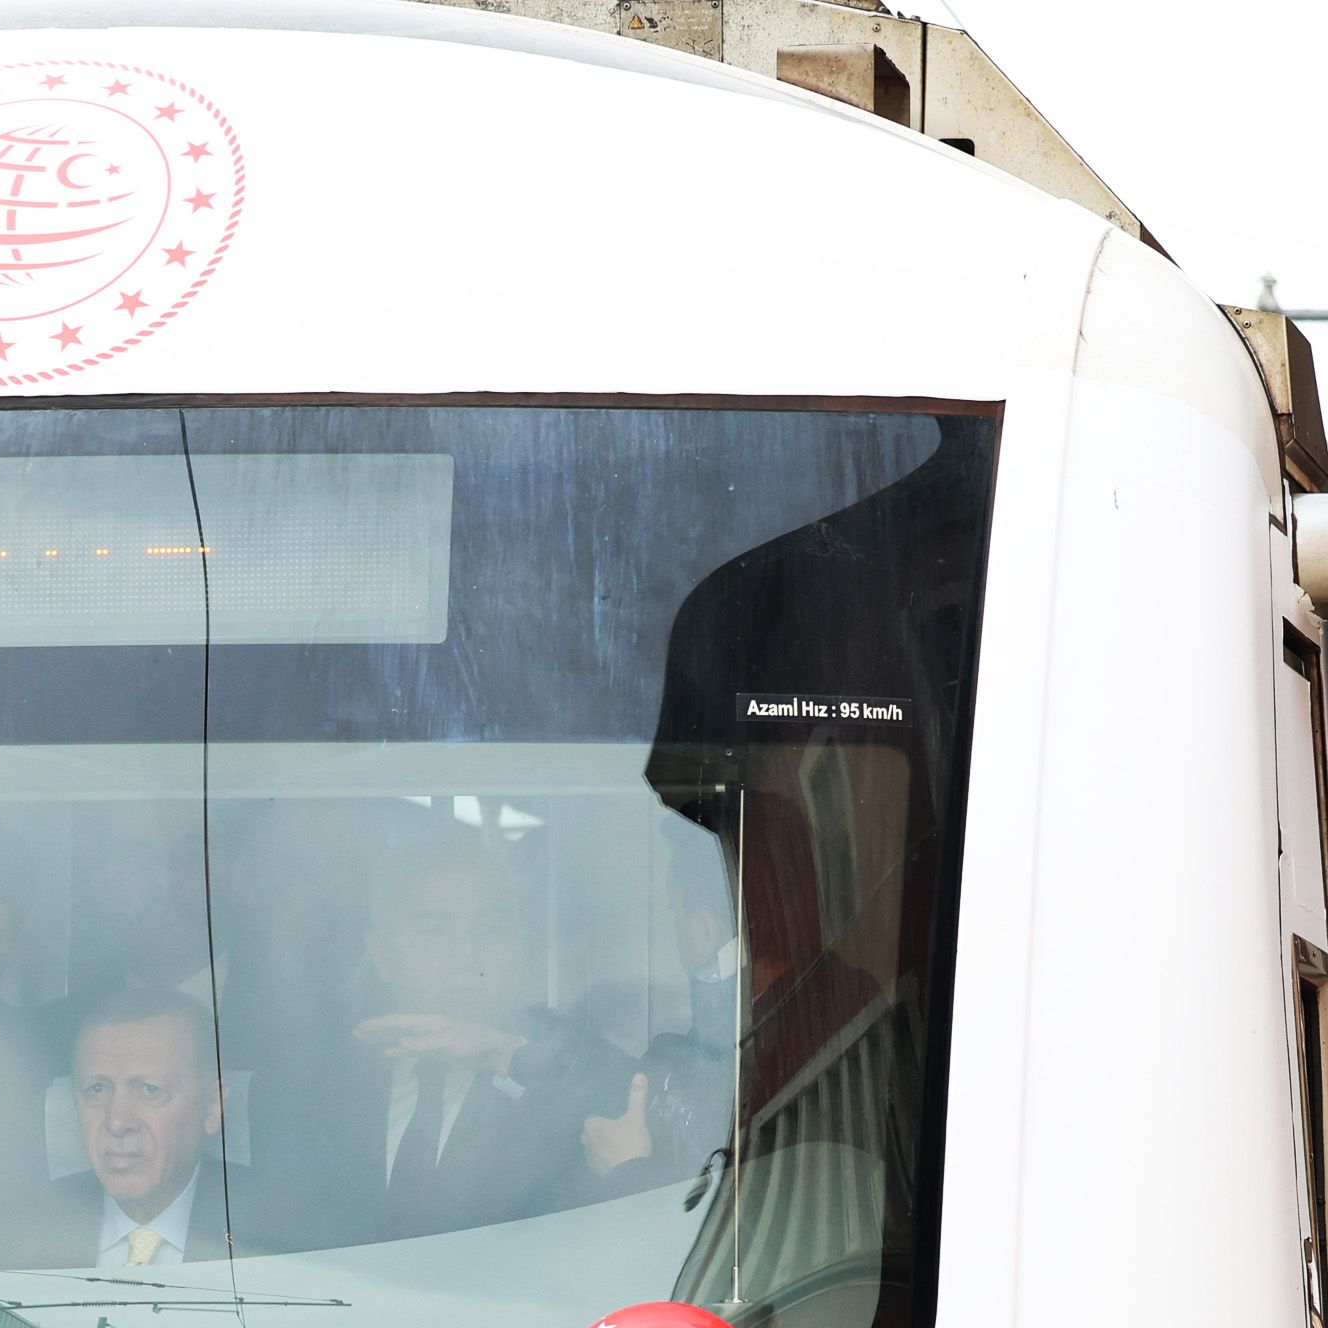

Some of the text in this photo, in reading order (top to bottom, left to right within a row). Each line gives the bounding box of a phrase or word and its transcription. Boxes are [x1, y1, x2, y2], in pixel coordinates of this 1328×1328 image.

[801, 701, 828, 717] Hız
[839, 702, 860, 719] 95
[863, 703, 903, 721] km/h
